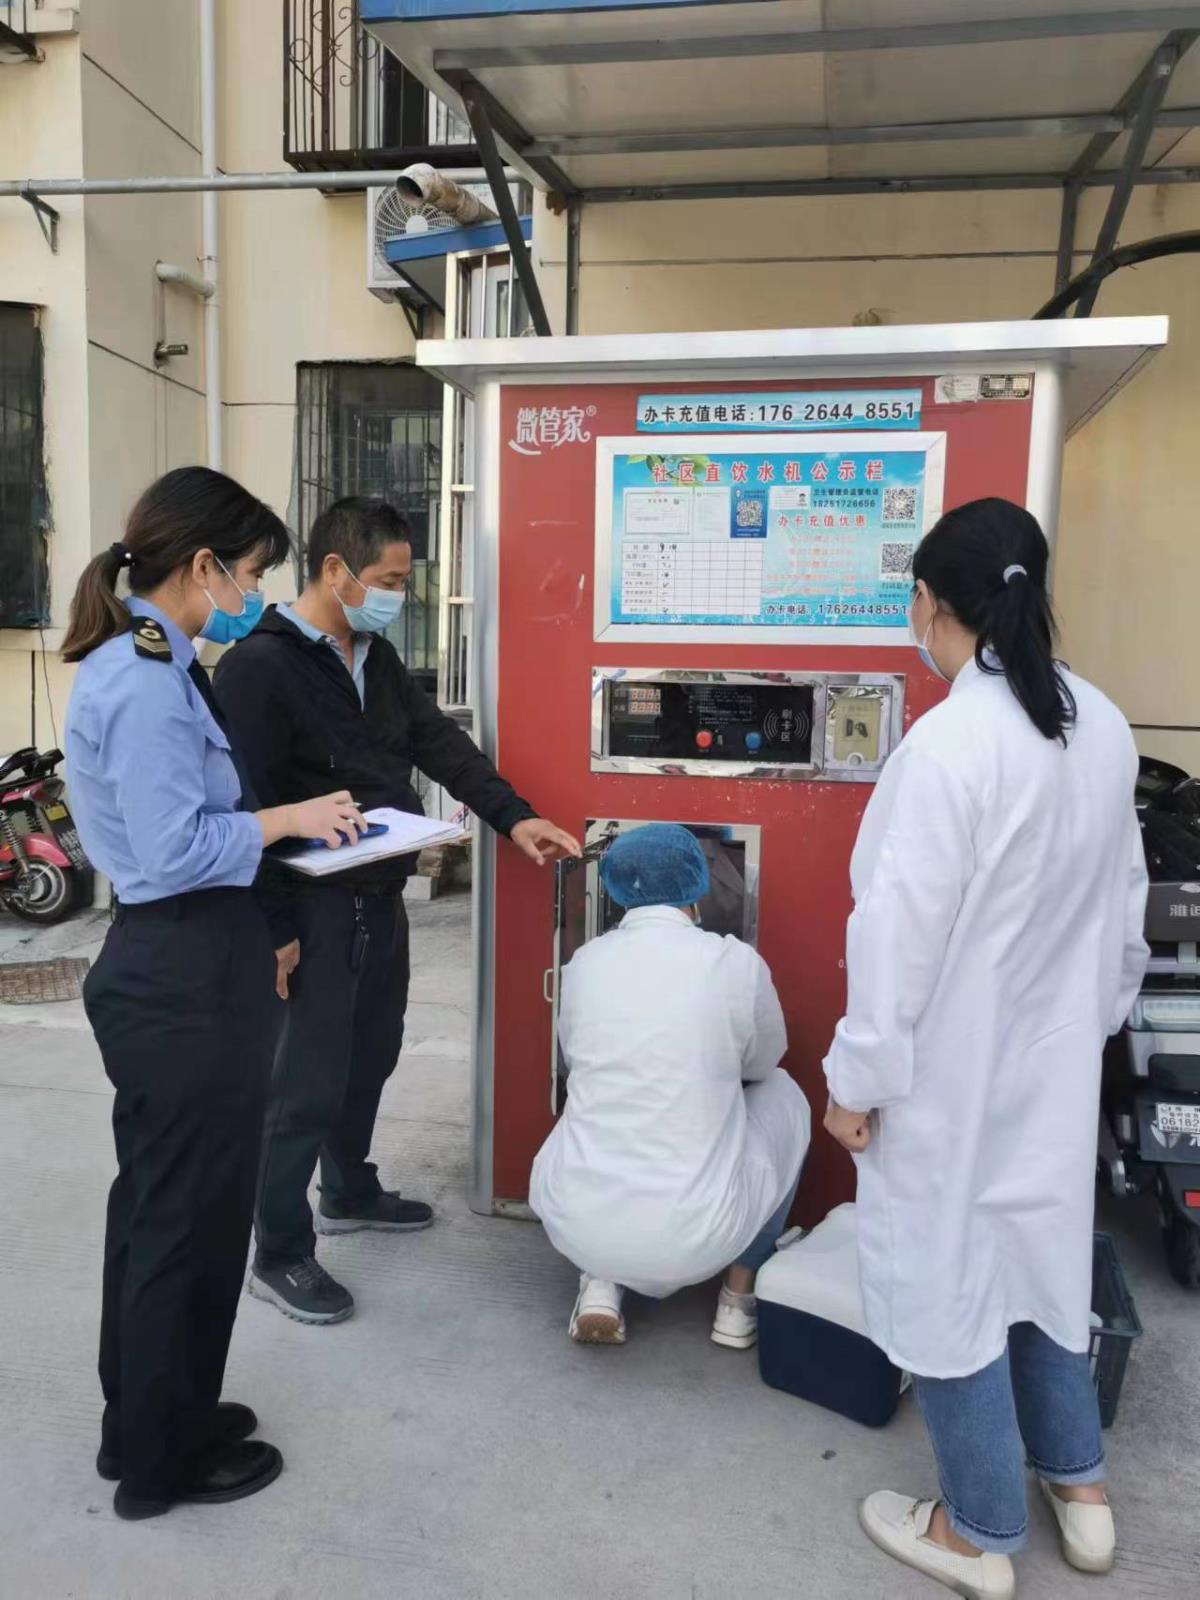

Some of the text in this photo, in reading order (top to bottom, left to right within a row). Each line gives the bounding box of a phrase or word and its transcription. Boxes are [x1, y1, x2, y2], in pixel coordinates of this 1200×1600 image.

[804, 403, 853, 421] 2644
[865, 401, 915, 420] 8551
[653, 461, 883, 483] 社区直饮水机公示栏
[778, 515, 866, 527] 办卡充值优惠
[818, 604, 907, 615] 17626448551
